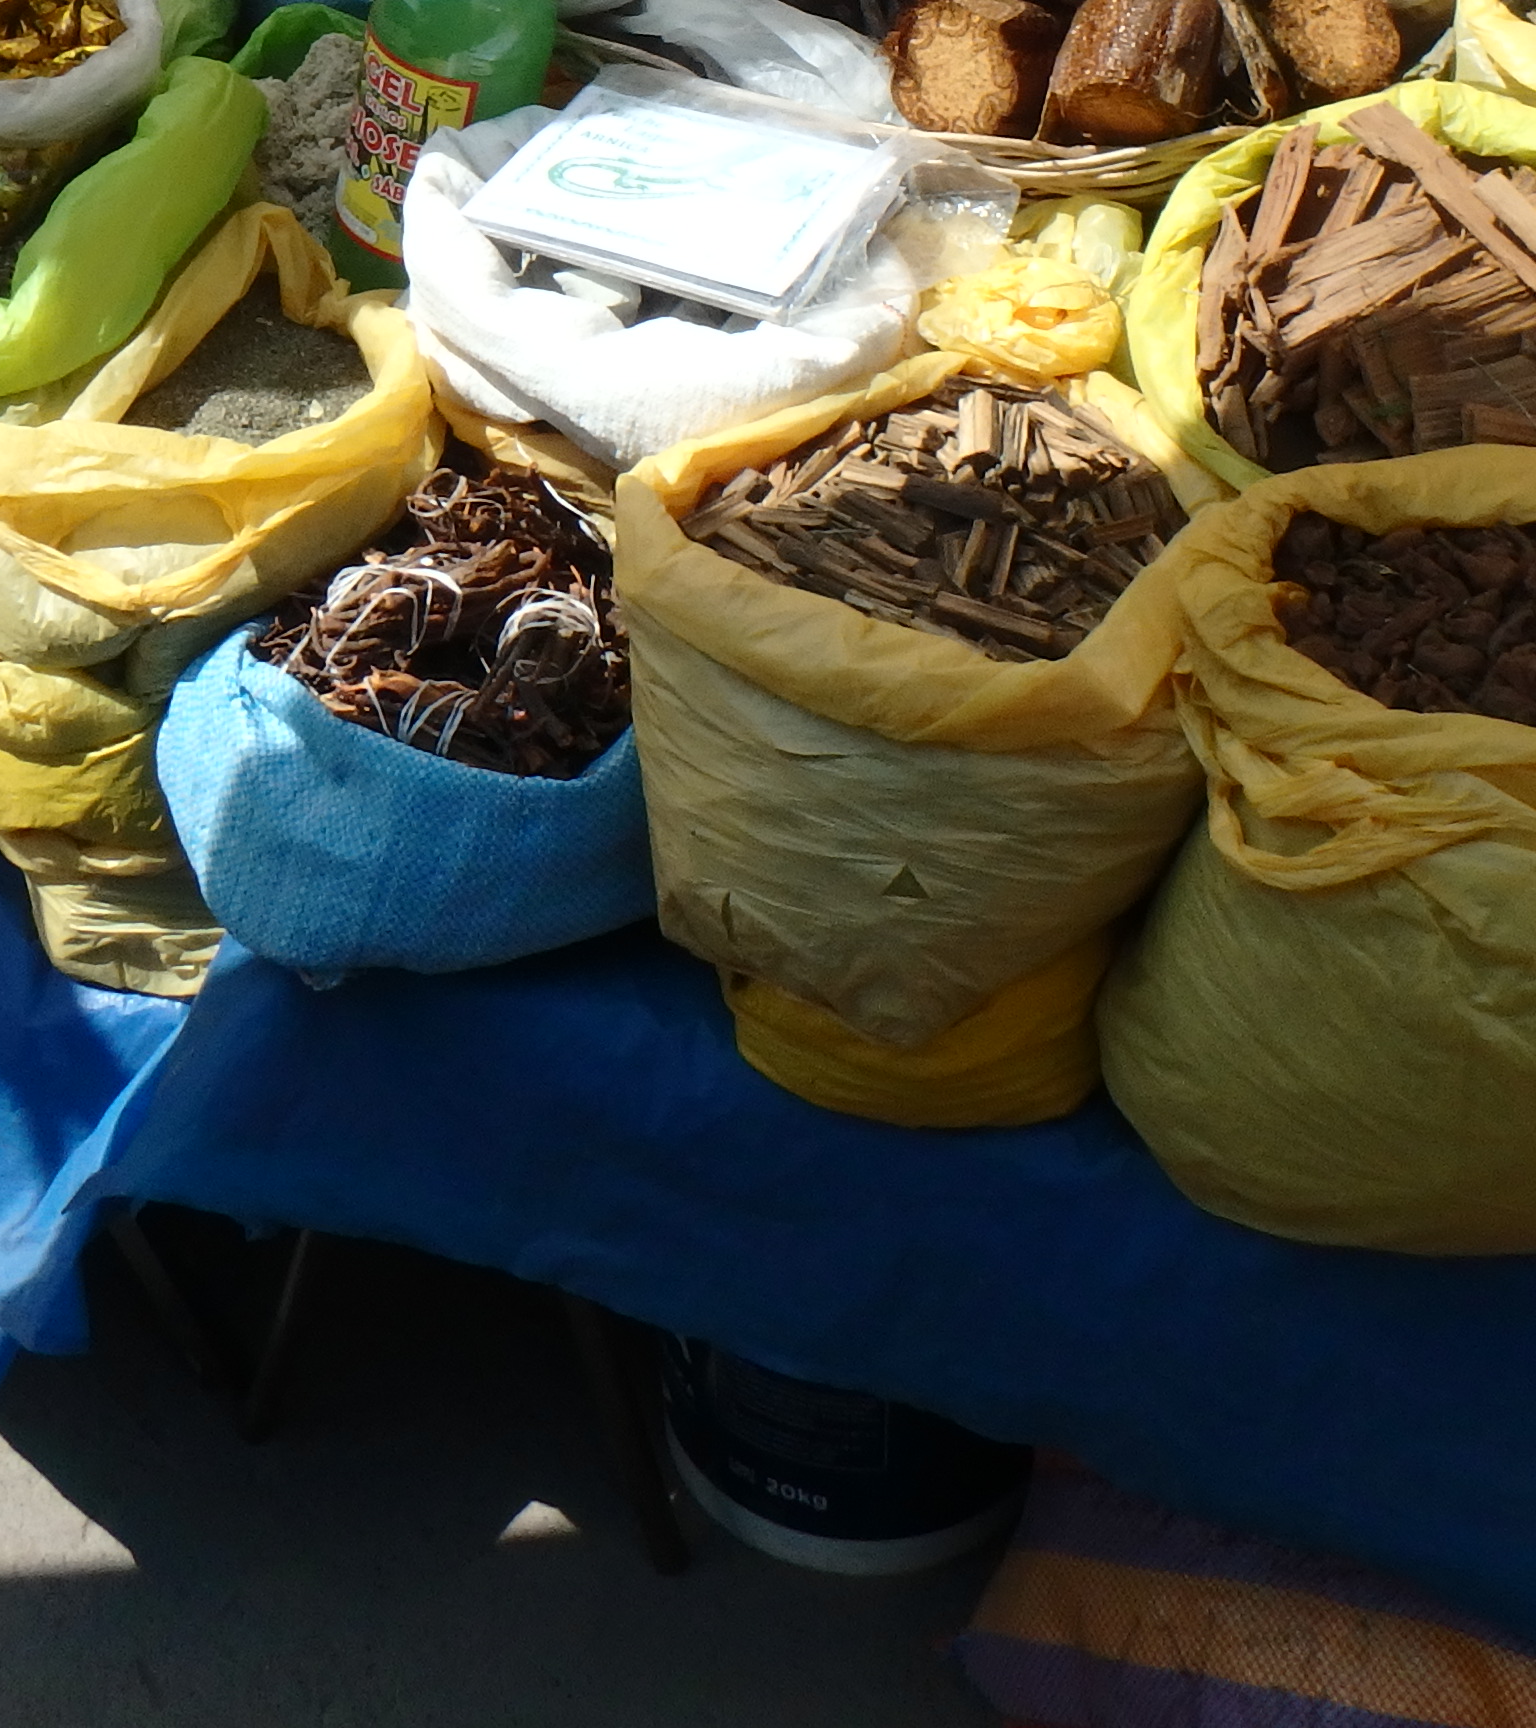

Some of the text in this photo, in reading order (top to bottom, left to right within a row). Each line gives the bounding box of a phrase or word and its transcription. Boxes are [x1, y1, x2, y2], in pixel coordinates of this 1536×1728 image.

[365, 52, 424, 116] GEL
[351, 105, 422, 172] IOSE
[580, 130, 650, 153] ARNICA
[371, 173, 407, 204] SÁB
